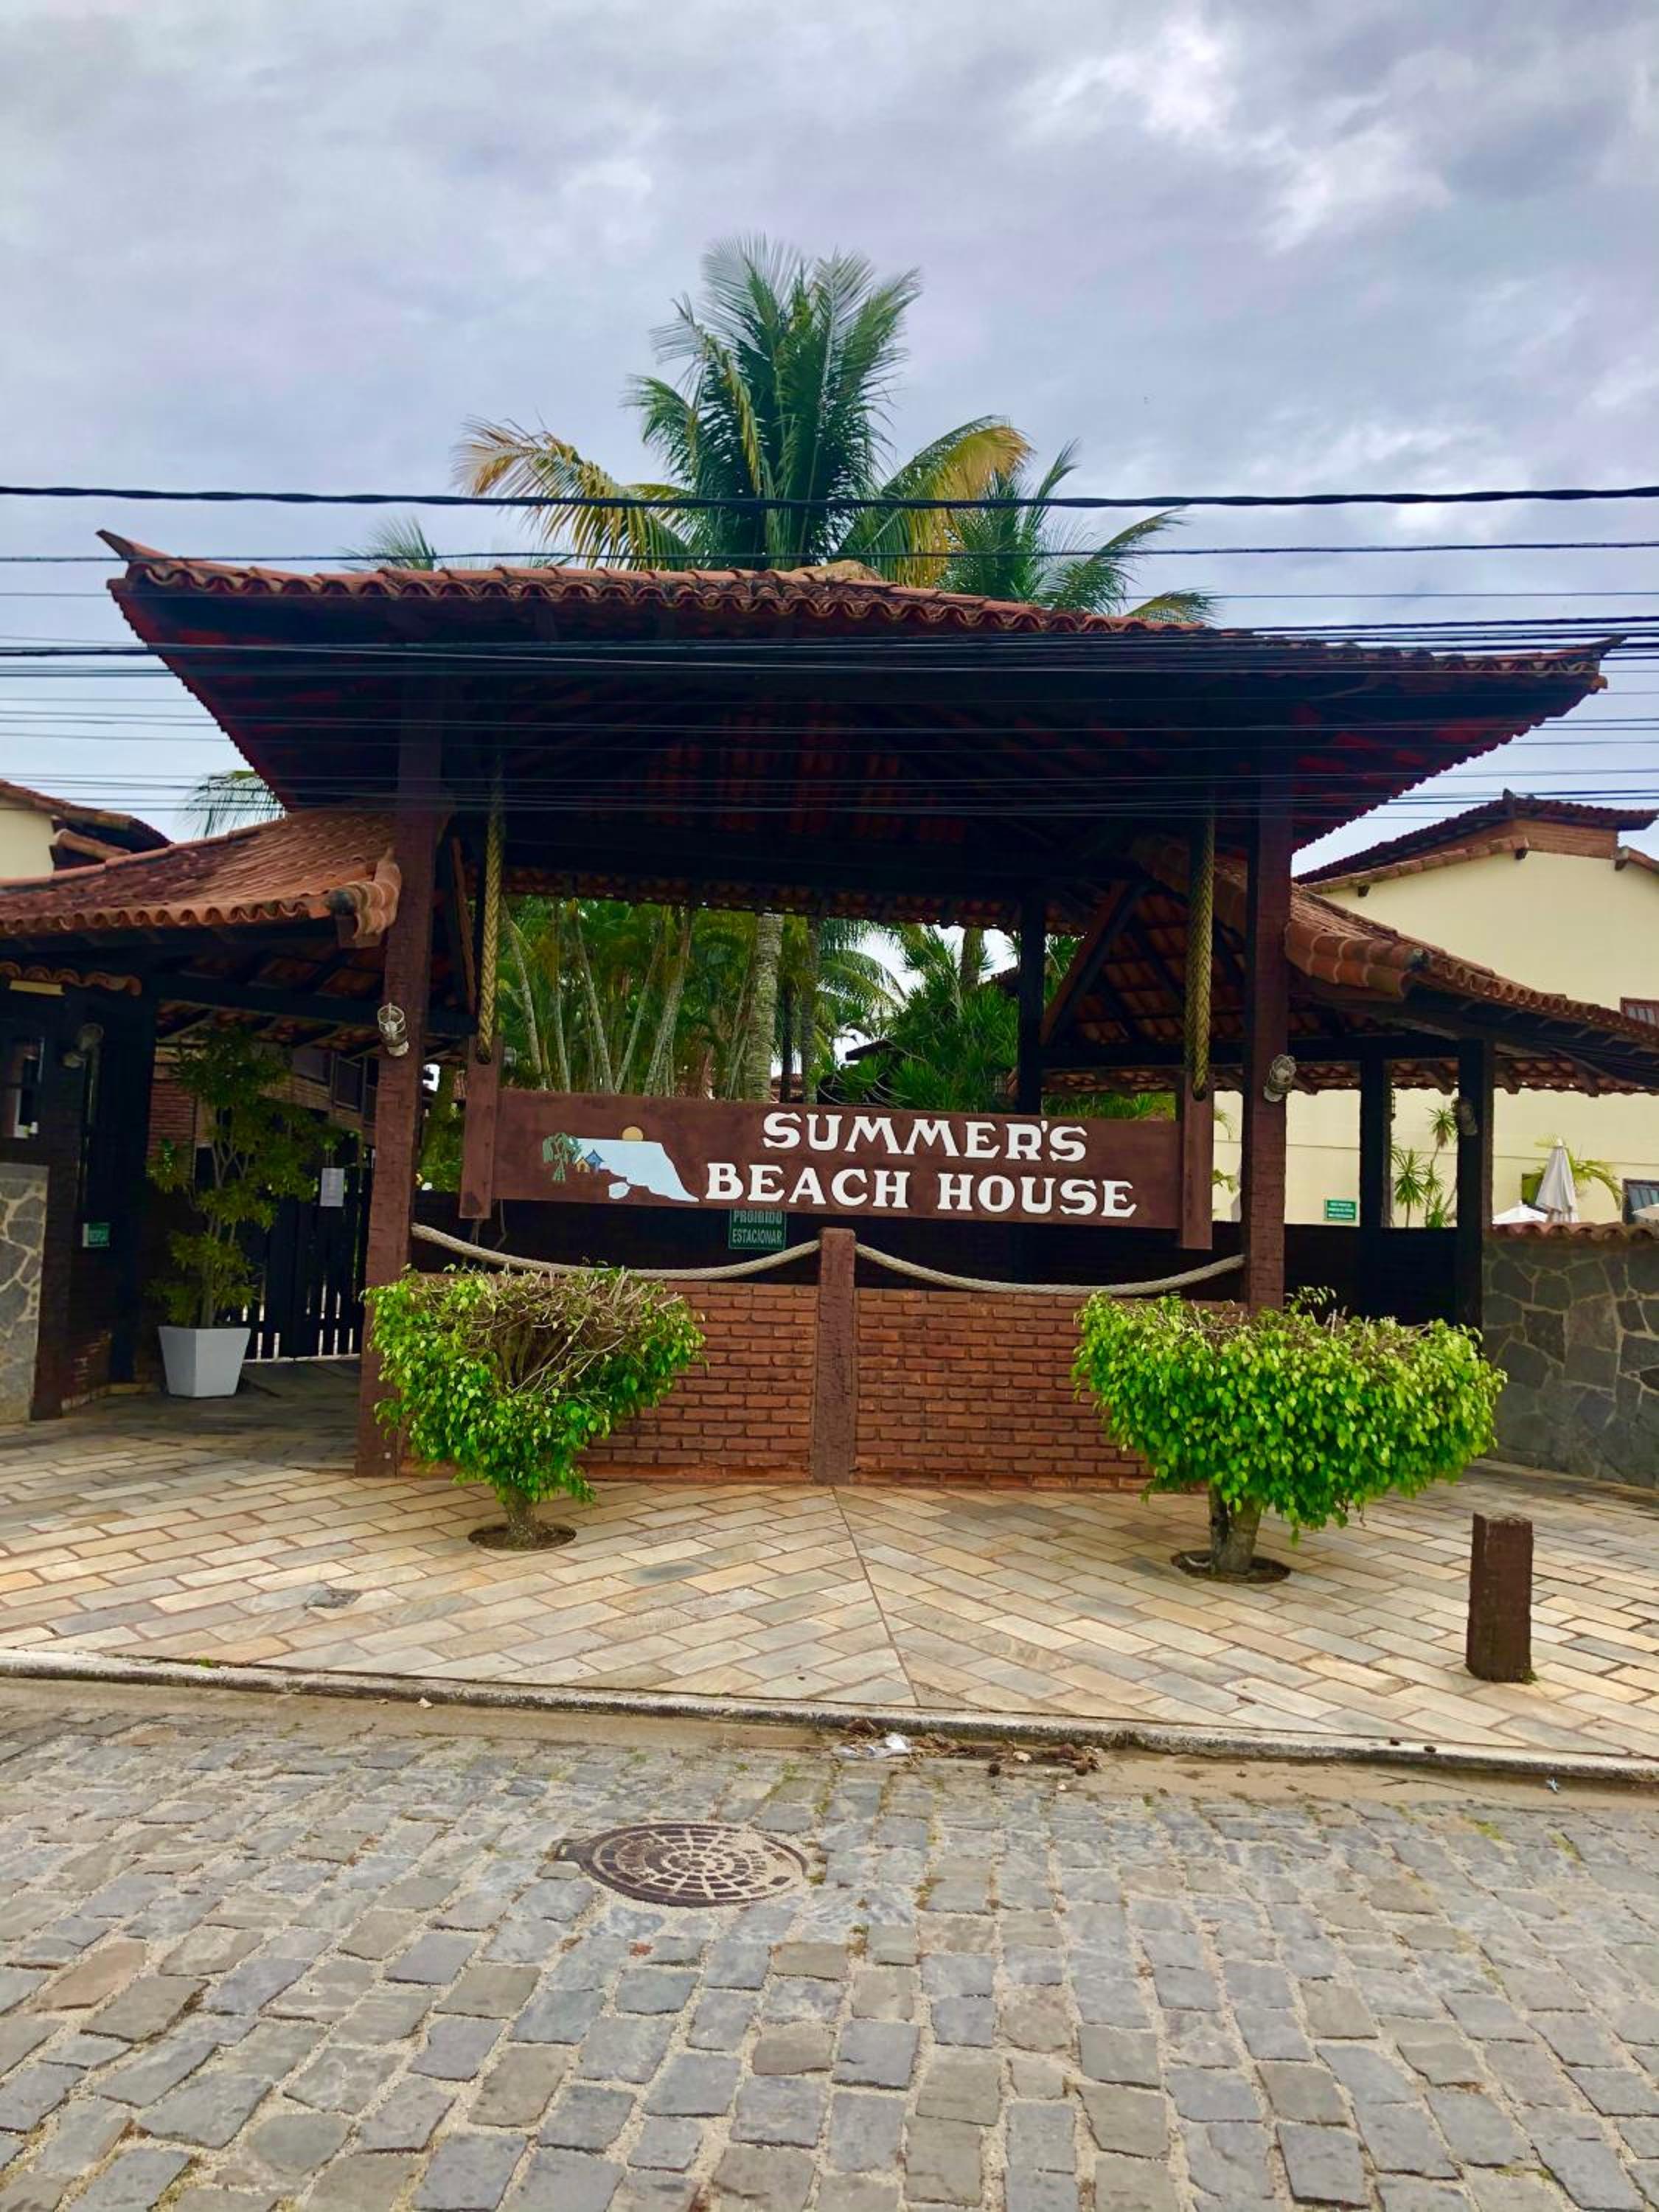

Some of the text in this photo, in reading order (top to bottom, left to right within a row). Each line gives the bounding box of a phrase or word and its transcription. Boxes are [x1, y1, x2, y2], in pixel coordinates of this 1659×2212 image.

[762, 1112, 1088, 1162] SUMMER'S
[705, 1162, 1138, 1217] BEACH HOUSE
[733, 1209, 782, 1224] PROIBIDO
[732, 1228, 782, 1245] ESTACIONAR
